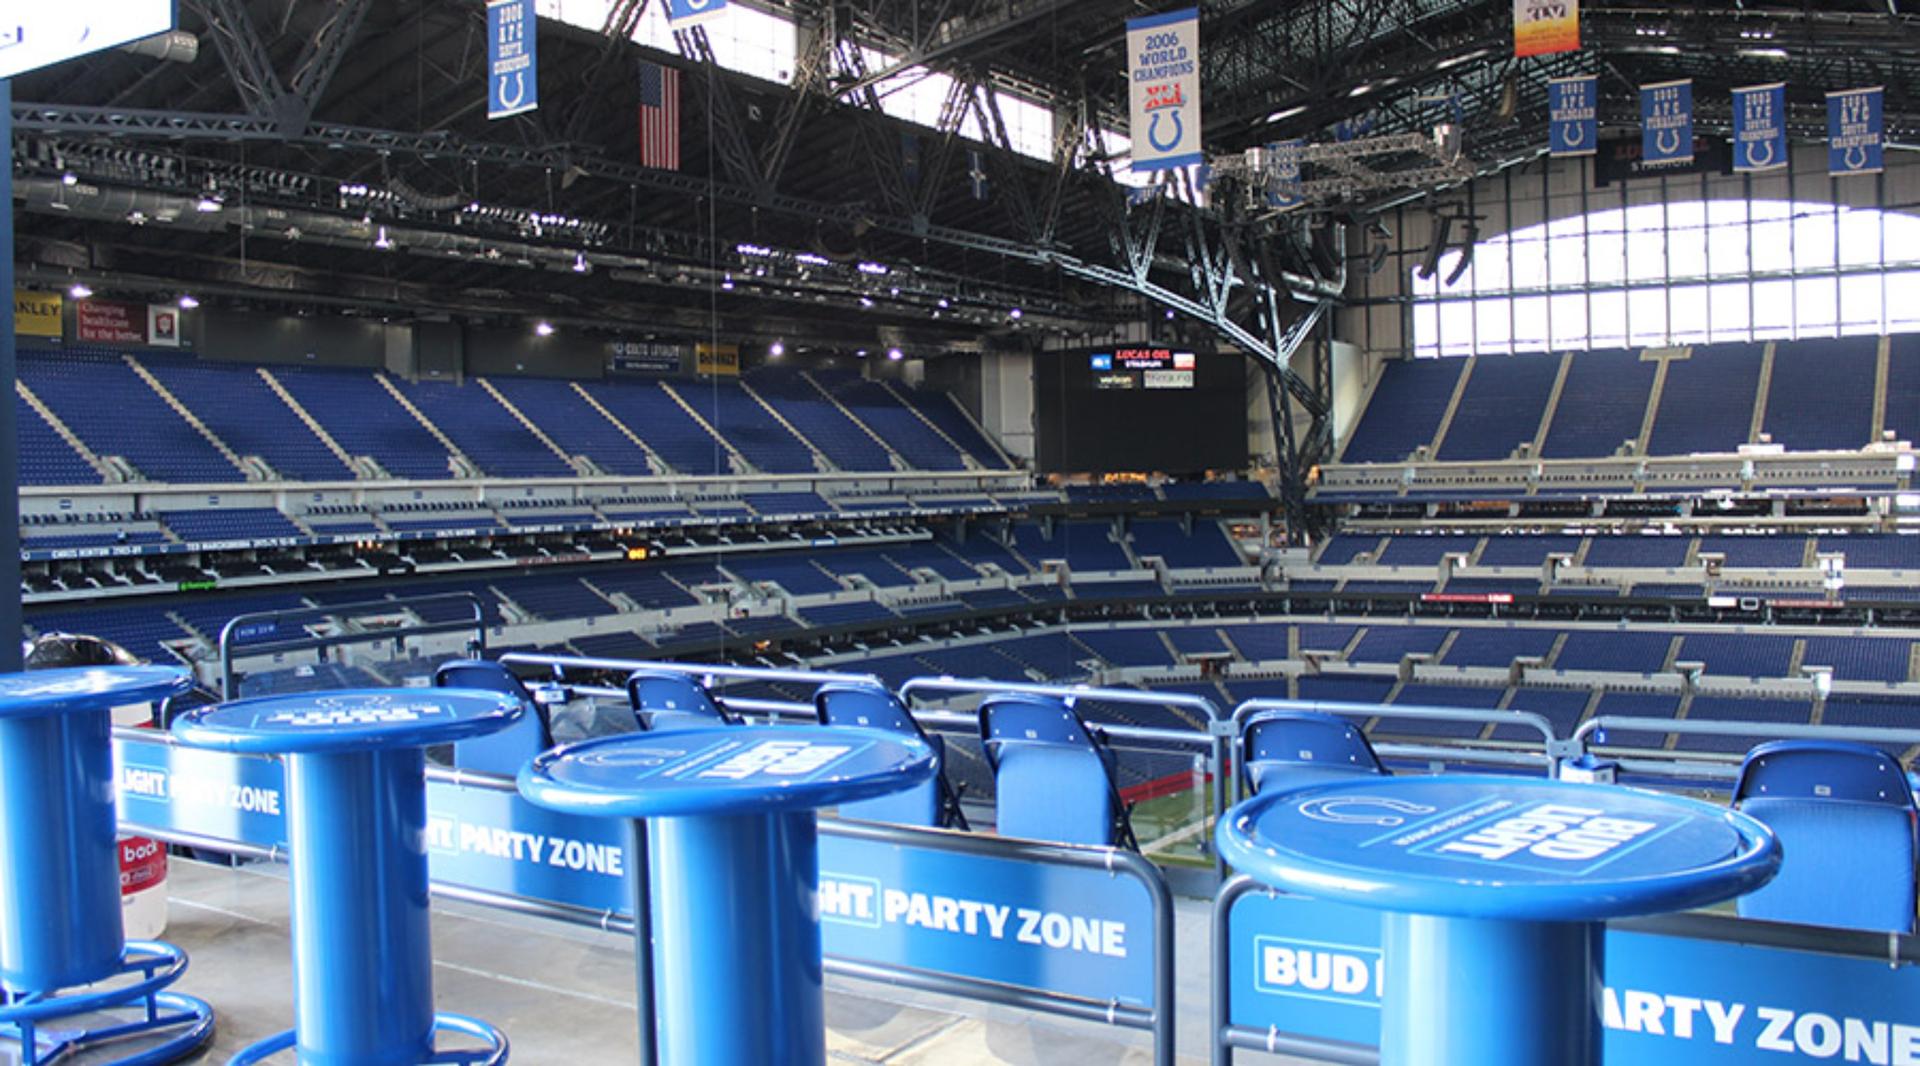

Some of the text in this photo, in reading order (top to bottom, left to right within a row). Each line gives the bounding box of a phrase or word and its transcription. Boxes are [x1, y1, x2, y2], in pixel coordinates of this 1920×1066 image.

[1139, 46, 1187, 66] WORLD
[1145, 32, 1179, 50] 2006
[1133, 61, 1194, 82] CHAMPIONS
[1116, 349, 1170, 359] LUCAS OIL
[230, 783, 280, 816] ZONE
[459, 822, 545, 864] PARTY
[547, 837, 624, 877] ZONE
[1529, 817, 1656, 860] BUD
[884, 889, 1011, 938] PARTY
[1016, 907, 1128, 958] ZONE
[1264, 946, 1369, 994] BUD
[1602, 986, 1920, 1066] ARTY ZONE
